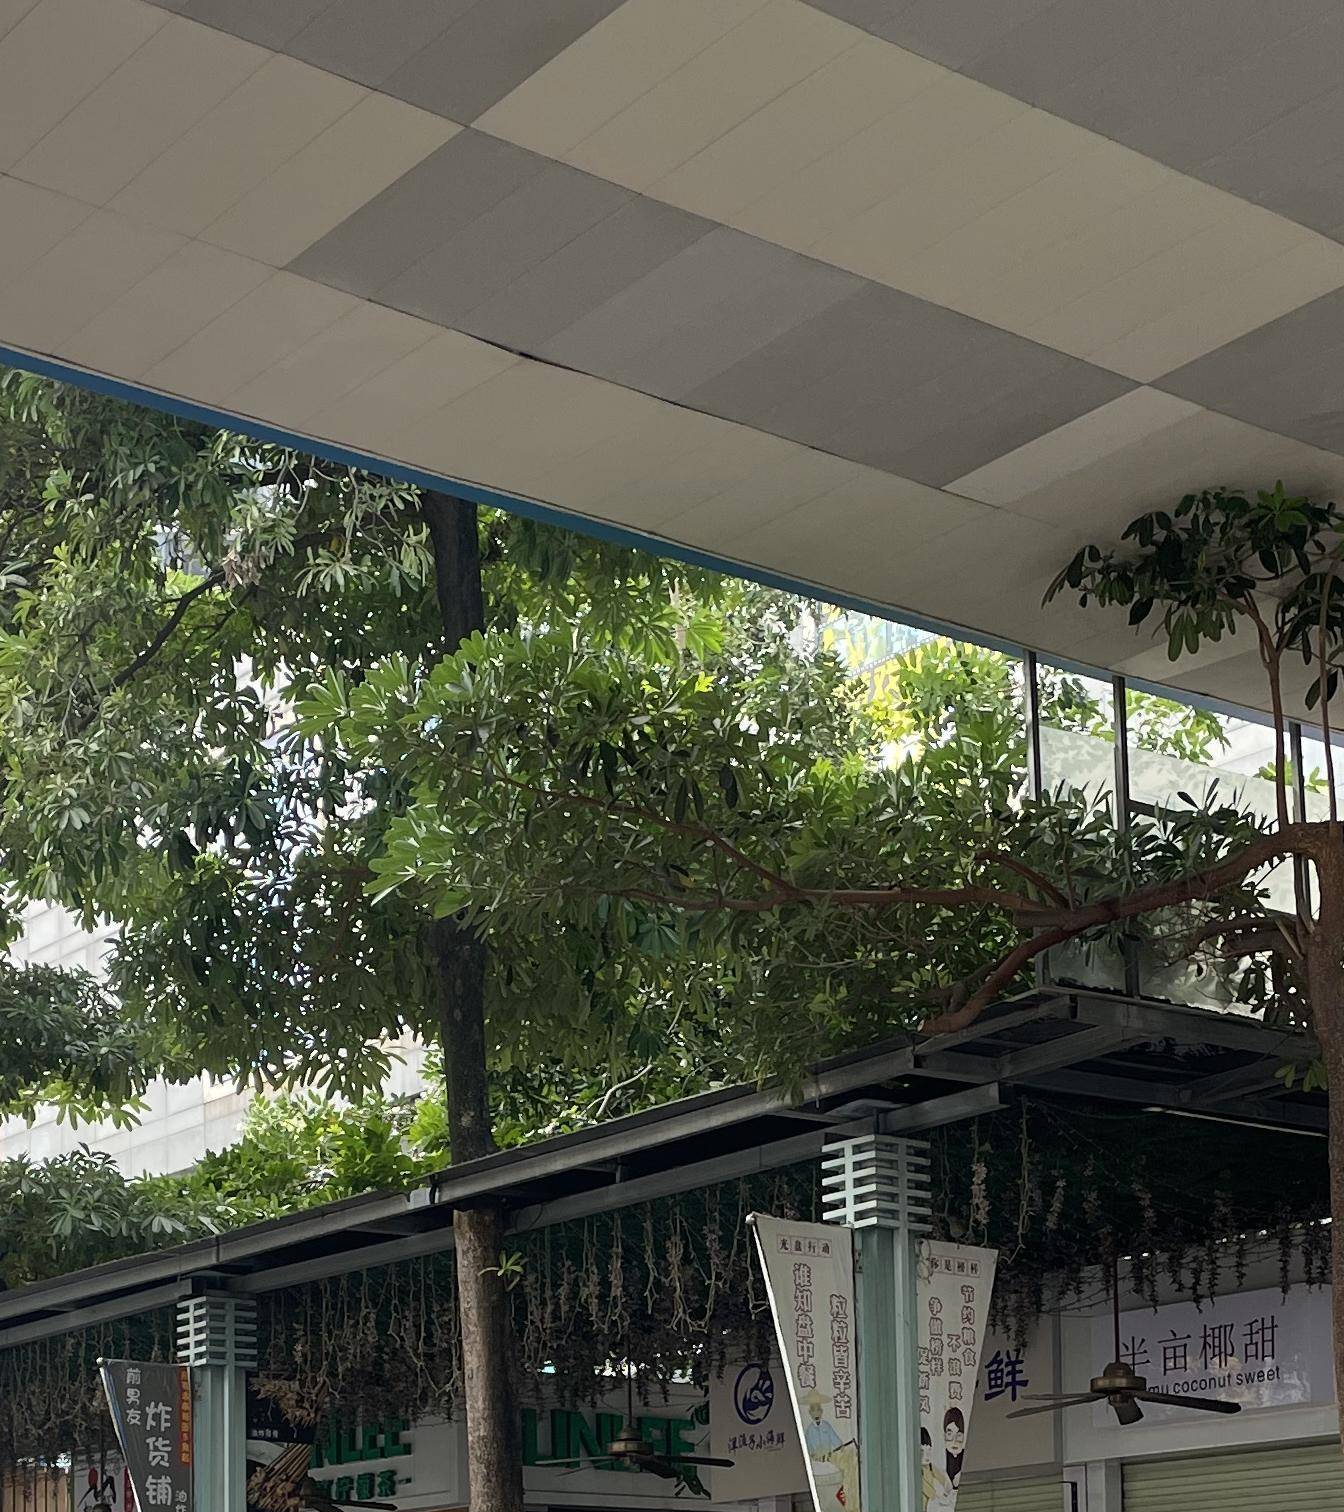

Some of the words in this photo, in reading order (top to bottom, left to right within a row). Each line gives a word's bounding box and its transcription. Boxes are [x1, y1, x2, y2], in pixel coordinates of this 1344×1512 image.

[793, 1263, 816, 1389] 谁知盘中餐
[829, 1294, 852, 1419] 粒粒皆辛苦
[960, 1284, 977, 1367] 节约粮食
[1120, 1314, 1280, 1376] 半亩椰甜
[125, 1367, 143, 1427] 前男友
[983, 1350, 1030, 1402] 鲜
[1172, 1373, 1233, 1394] coconut
[1235, 1365, 1281, 1388] sweet
[145, 1400, 173, 1507] 炸货铺
